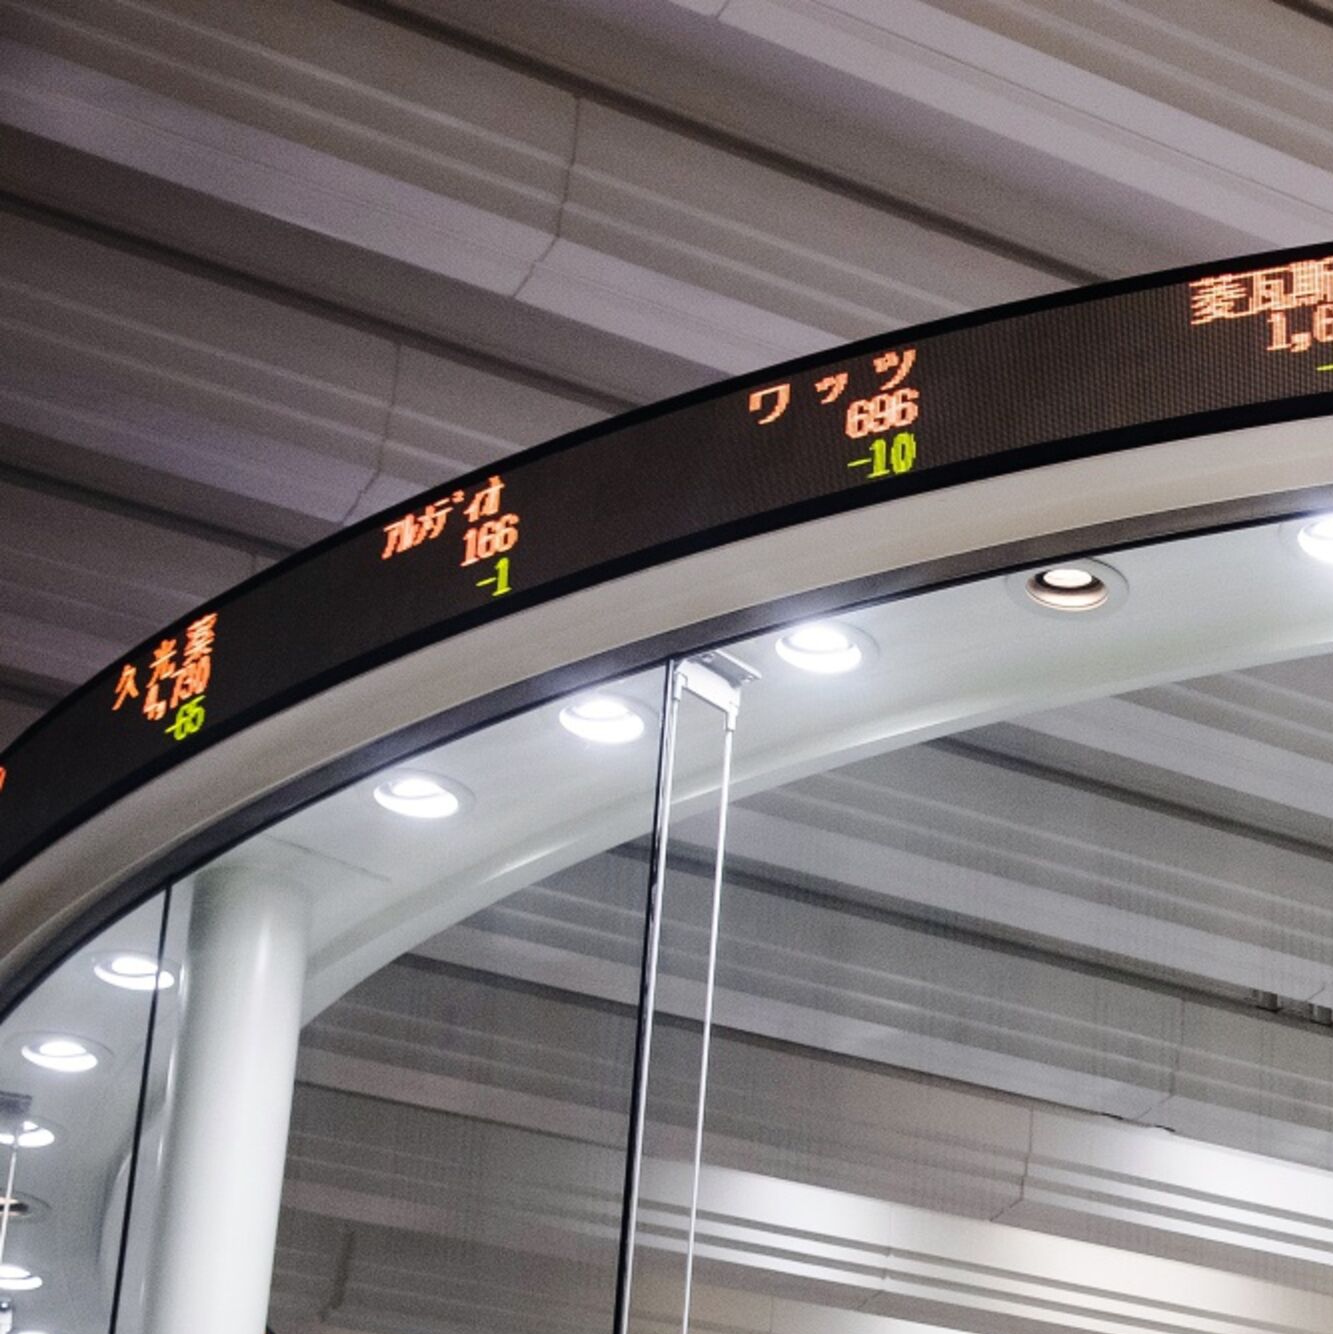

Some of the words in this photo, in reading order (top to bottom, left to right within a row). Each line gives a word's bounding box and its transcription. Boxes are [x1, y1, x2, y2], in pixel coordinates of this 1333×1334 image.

[749, 349, 916, 425] ワッツ
[845, 387, 920, 439] 696
[847, 432, 916, 478] -10
[460, 513, 520, 567] 166
[475, 557, 512, 597] -1
